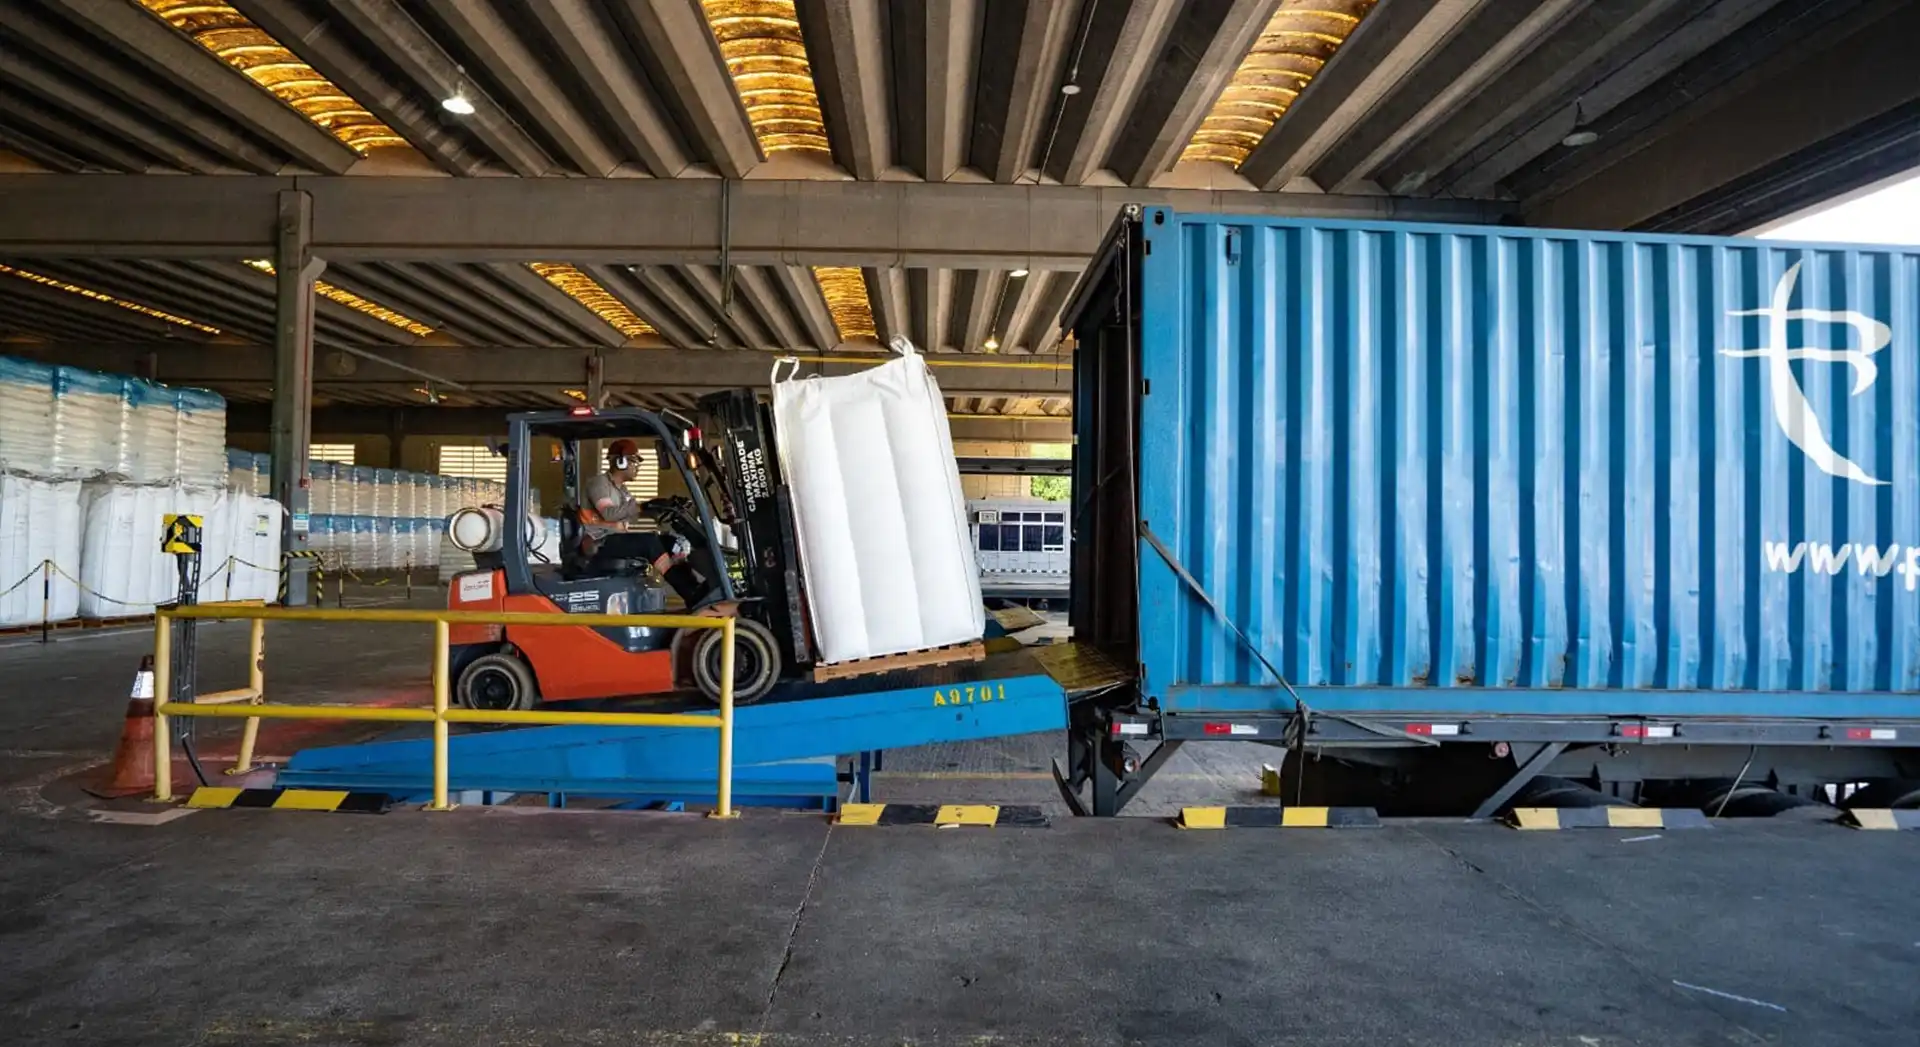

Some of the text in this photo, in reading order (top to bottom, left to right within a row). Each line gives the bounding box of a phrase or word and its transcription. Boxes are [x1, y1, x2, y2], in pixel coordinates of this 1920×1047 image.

[754, 448, 763, 466] KG
[737, 440, 756, 512] CAPACIDADE
[569, 590, 600, 603] 25
